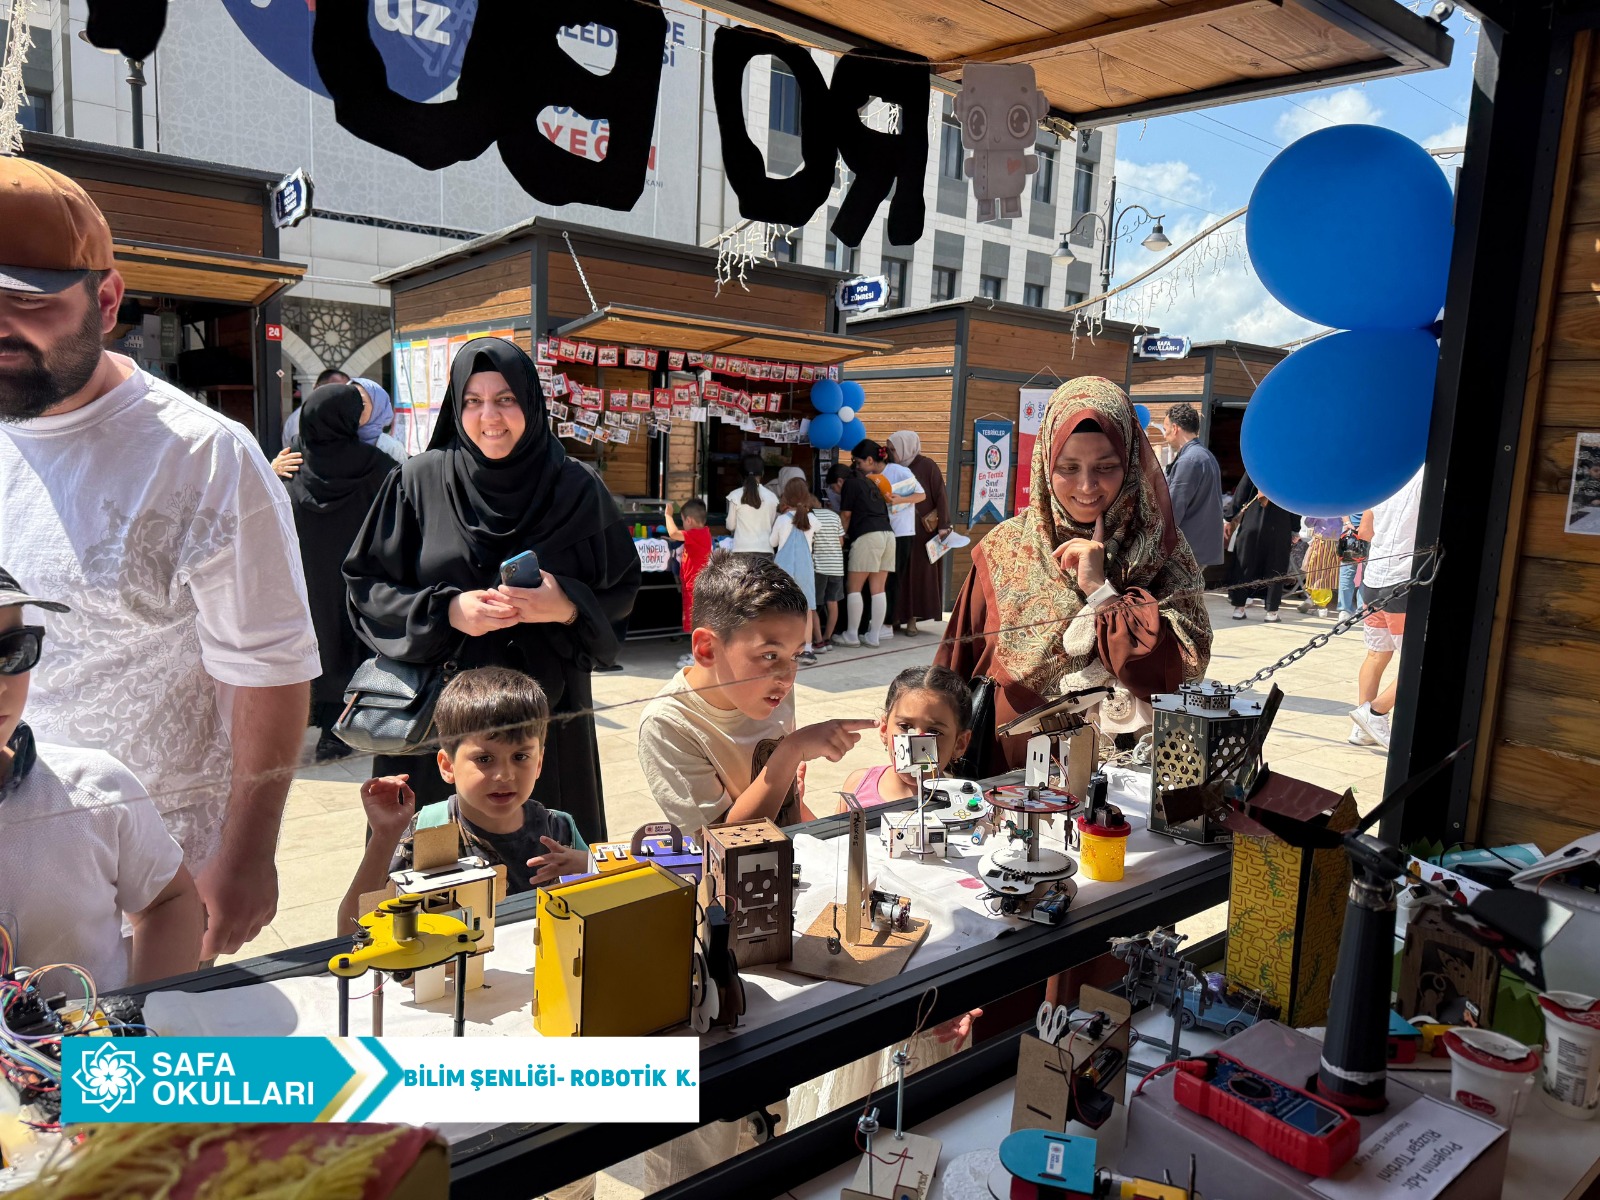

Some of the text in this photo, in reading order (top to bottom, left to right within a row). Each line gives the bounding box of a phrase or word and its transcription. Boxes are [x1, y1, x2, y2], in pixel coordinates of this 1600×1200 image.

[856, 285, 868, 293] PDR
[268, 327, 280, 337] 24
[982, 428, 1005, 437] TEBRİKLER
[978, 470, 1004, 480] En Temiz
[1409, 1129, 1441, 1158] Rüzgar
[1419, 1141, 1463, 1175] Projemin
